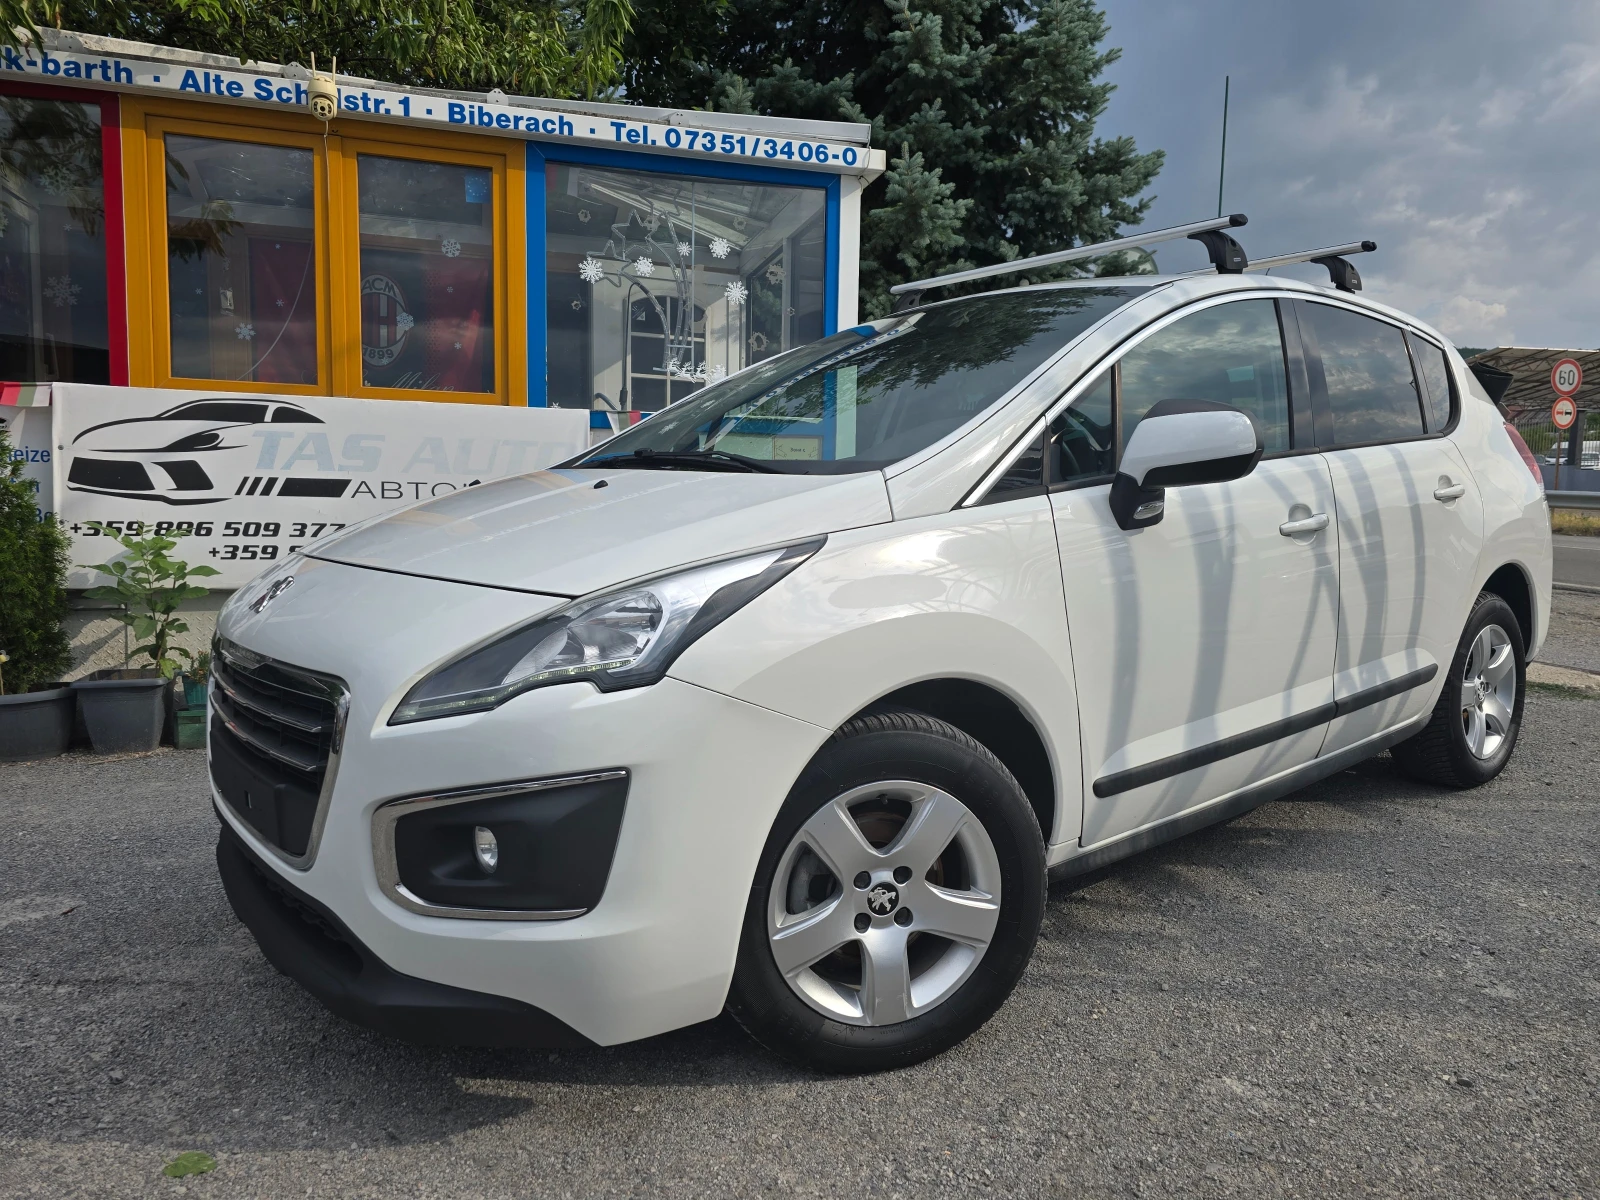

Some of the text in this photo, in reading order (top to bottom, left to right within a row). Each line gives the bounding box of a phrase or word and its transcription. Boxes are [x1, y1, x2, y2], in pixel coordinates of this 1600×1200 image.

[179, 69, 244, 98] Alte
[253, 78, 391, 115] Schlstr.
[398, 96, 410, 117] 1
[447, 102, 574, 137] Biberach
[610, 121, 657, 146] Tel.
[664, 127, 858, 166] 07351/3406-0
[361, 277, 398, 299] ACM
[362, 347, 394, 360] 1899
[1558, 369, 1575, 386] 60
[251, 430, 386, 472] TAS
[70, 520, 145, 537] +359
[222, 521, 281, 537] 509
[208, 545, 279, 560] +359
